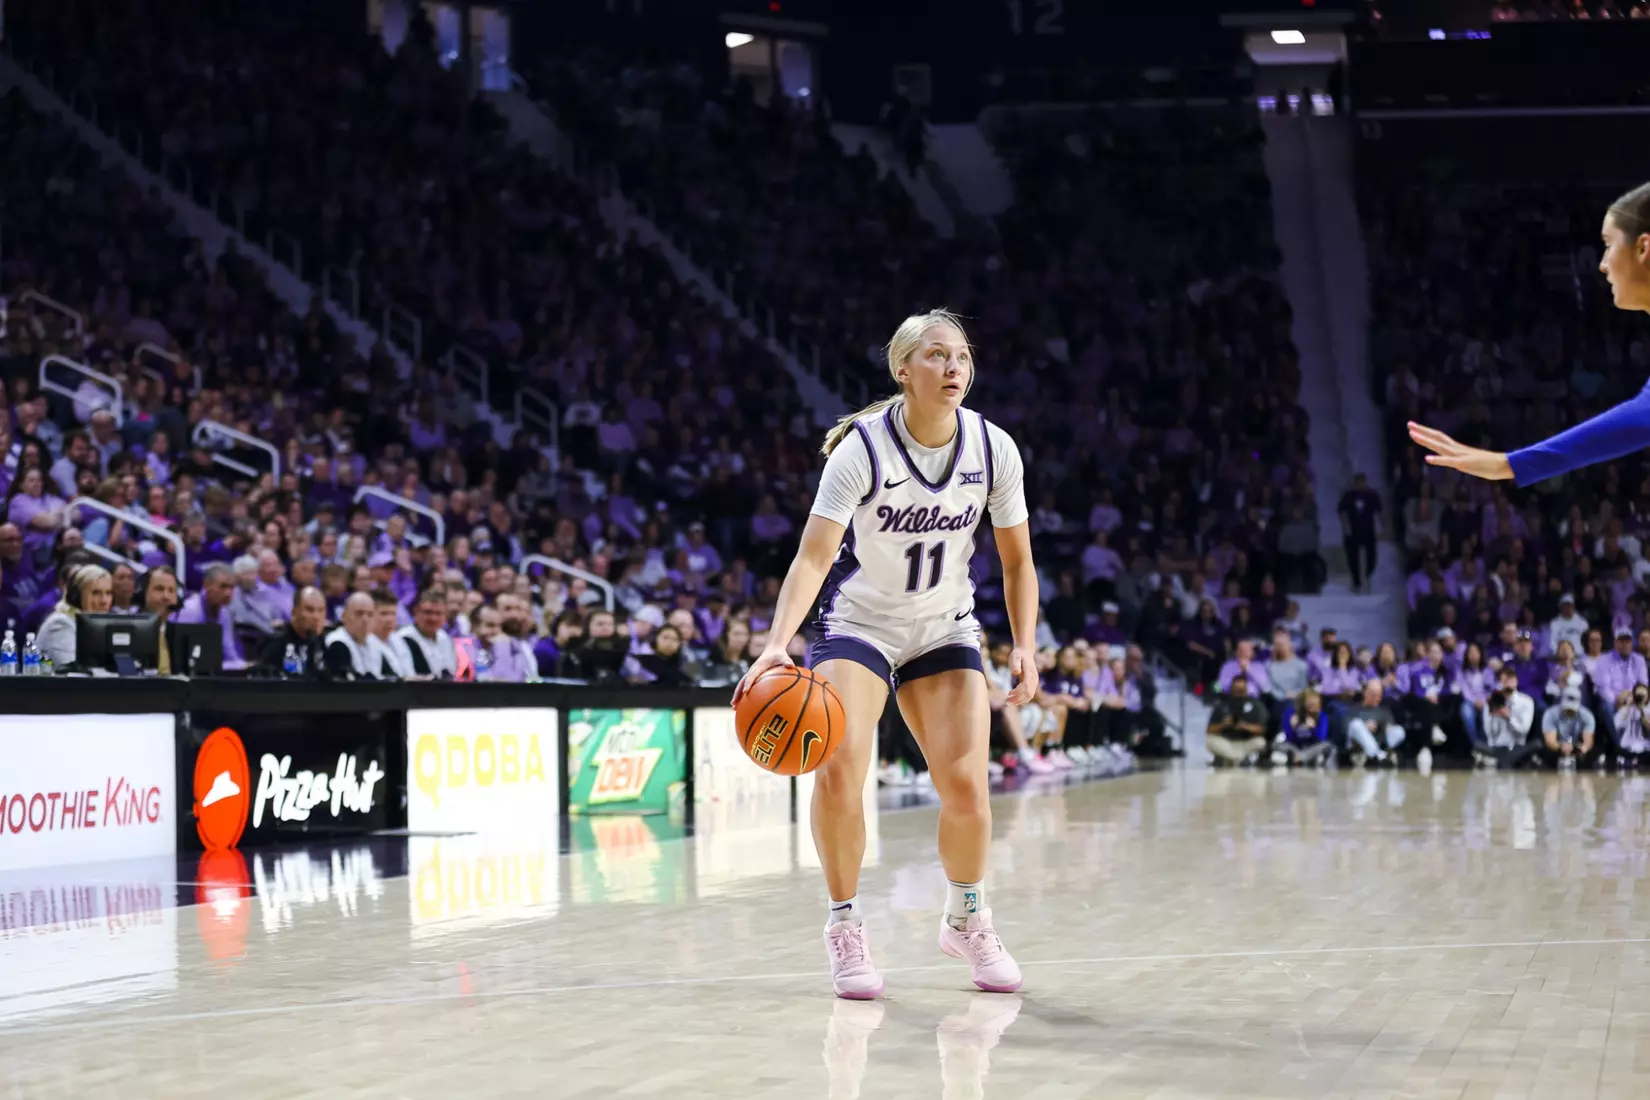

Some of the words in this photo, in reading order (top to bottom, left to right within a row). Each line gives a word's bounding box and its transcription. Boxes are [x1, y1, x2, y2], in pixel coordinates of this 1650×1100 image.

[1007, 0, 1066, 34] 12
[960, 471, 983, 485] XII
[877, 503, 977, 533] Wildcats
[905, 540, 946, 592] 11
[754, 713, 788, 766] ELITE
[253, 753, 330, 828] Pizza
[329, 752, 385, 817] Hut
[414, 733, 546, 809] QDOBA
